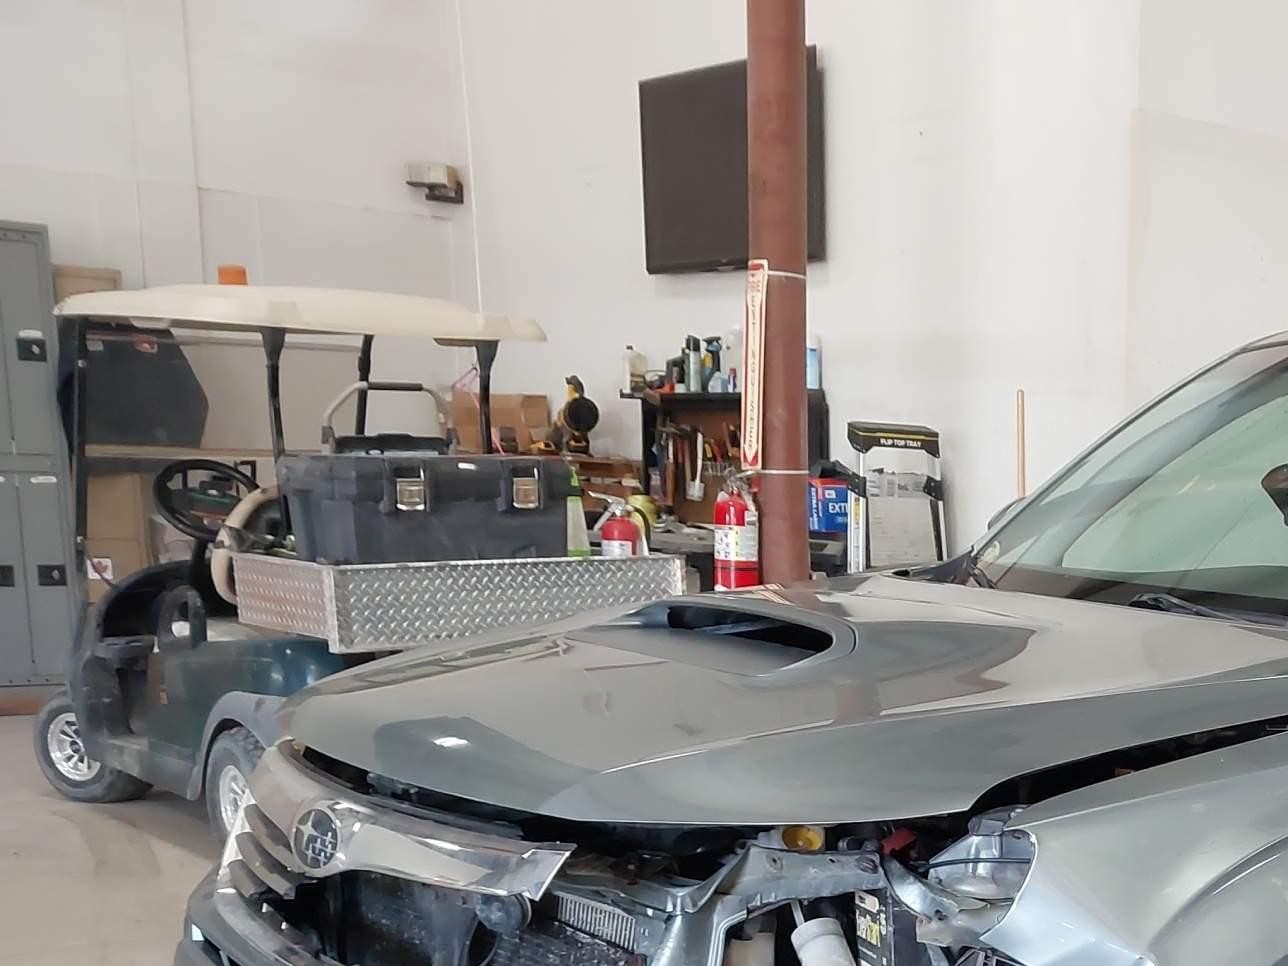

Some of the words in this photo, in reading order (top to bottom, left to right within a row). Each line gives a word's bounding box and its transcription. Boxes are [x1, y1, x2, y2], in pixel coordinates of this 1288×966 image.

[880, 437, 893, 446] FLIP
[894, 438, 905, 447] TOP
[906, 440, 921, 448] TRAY
